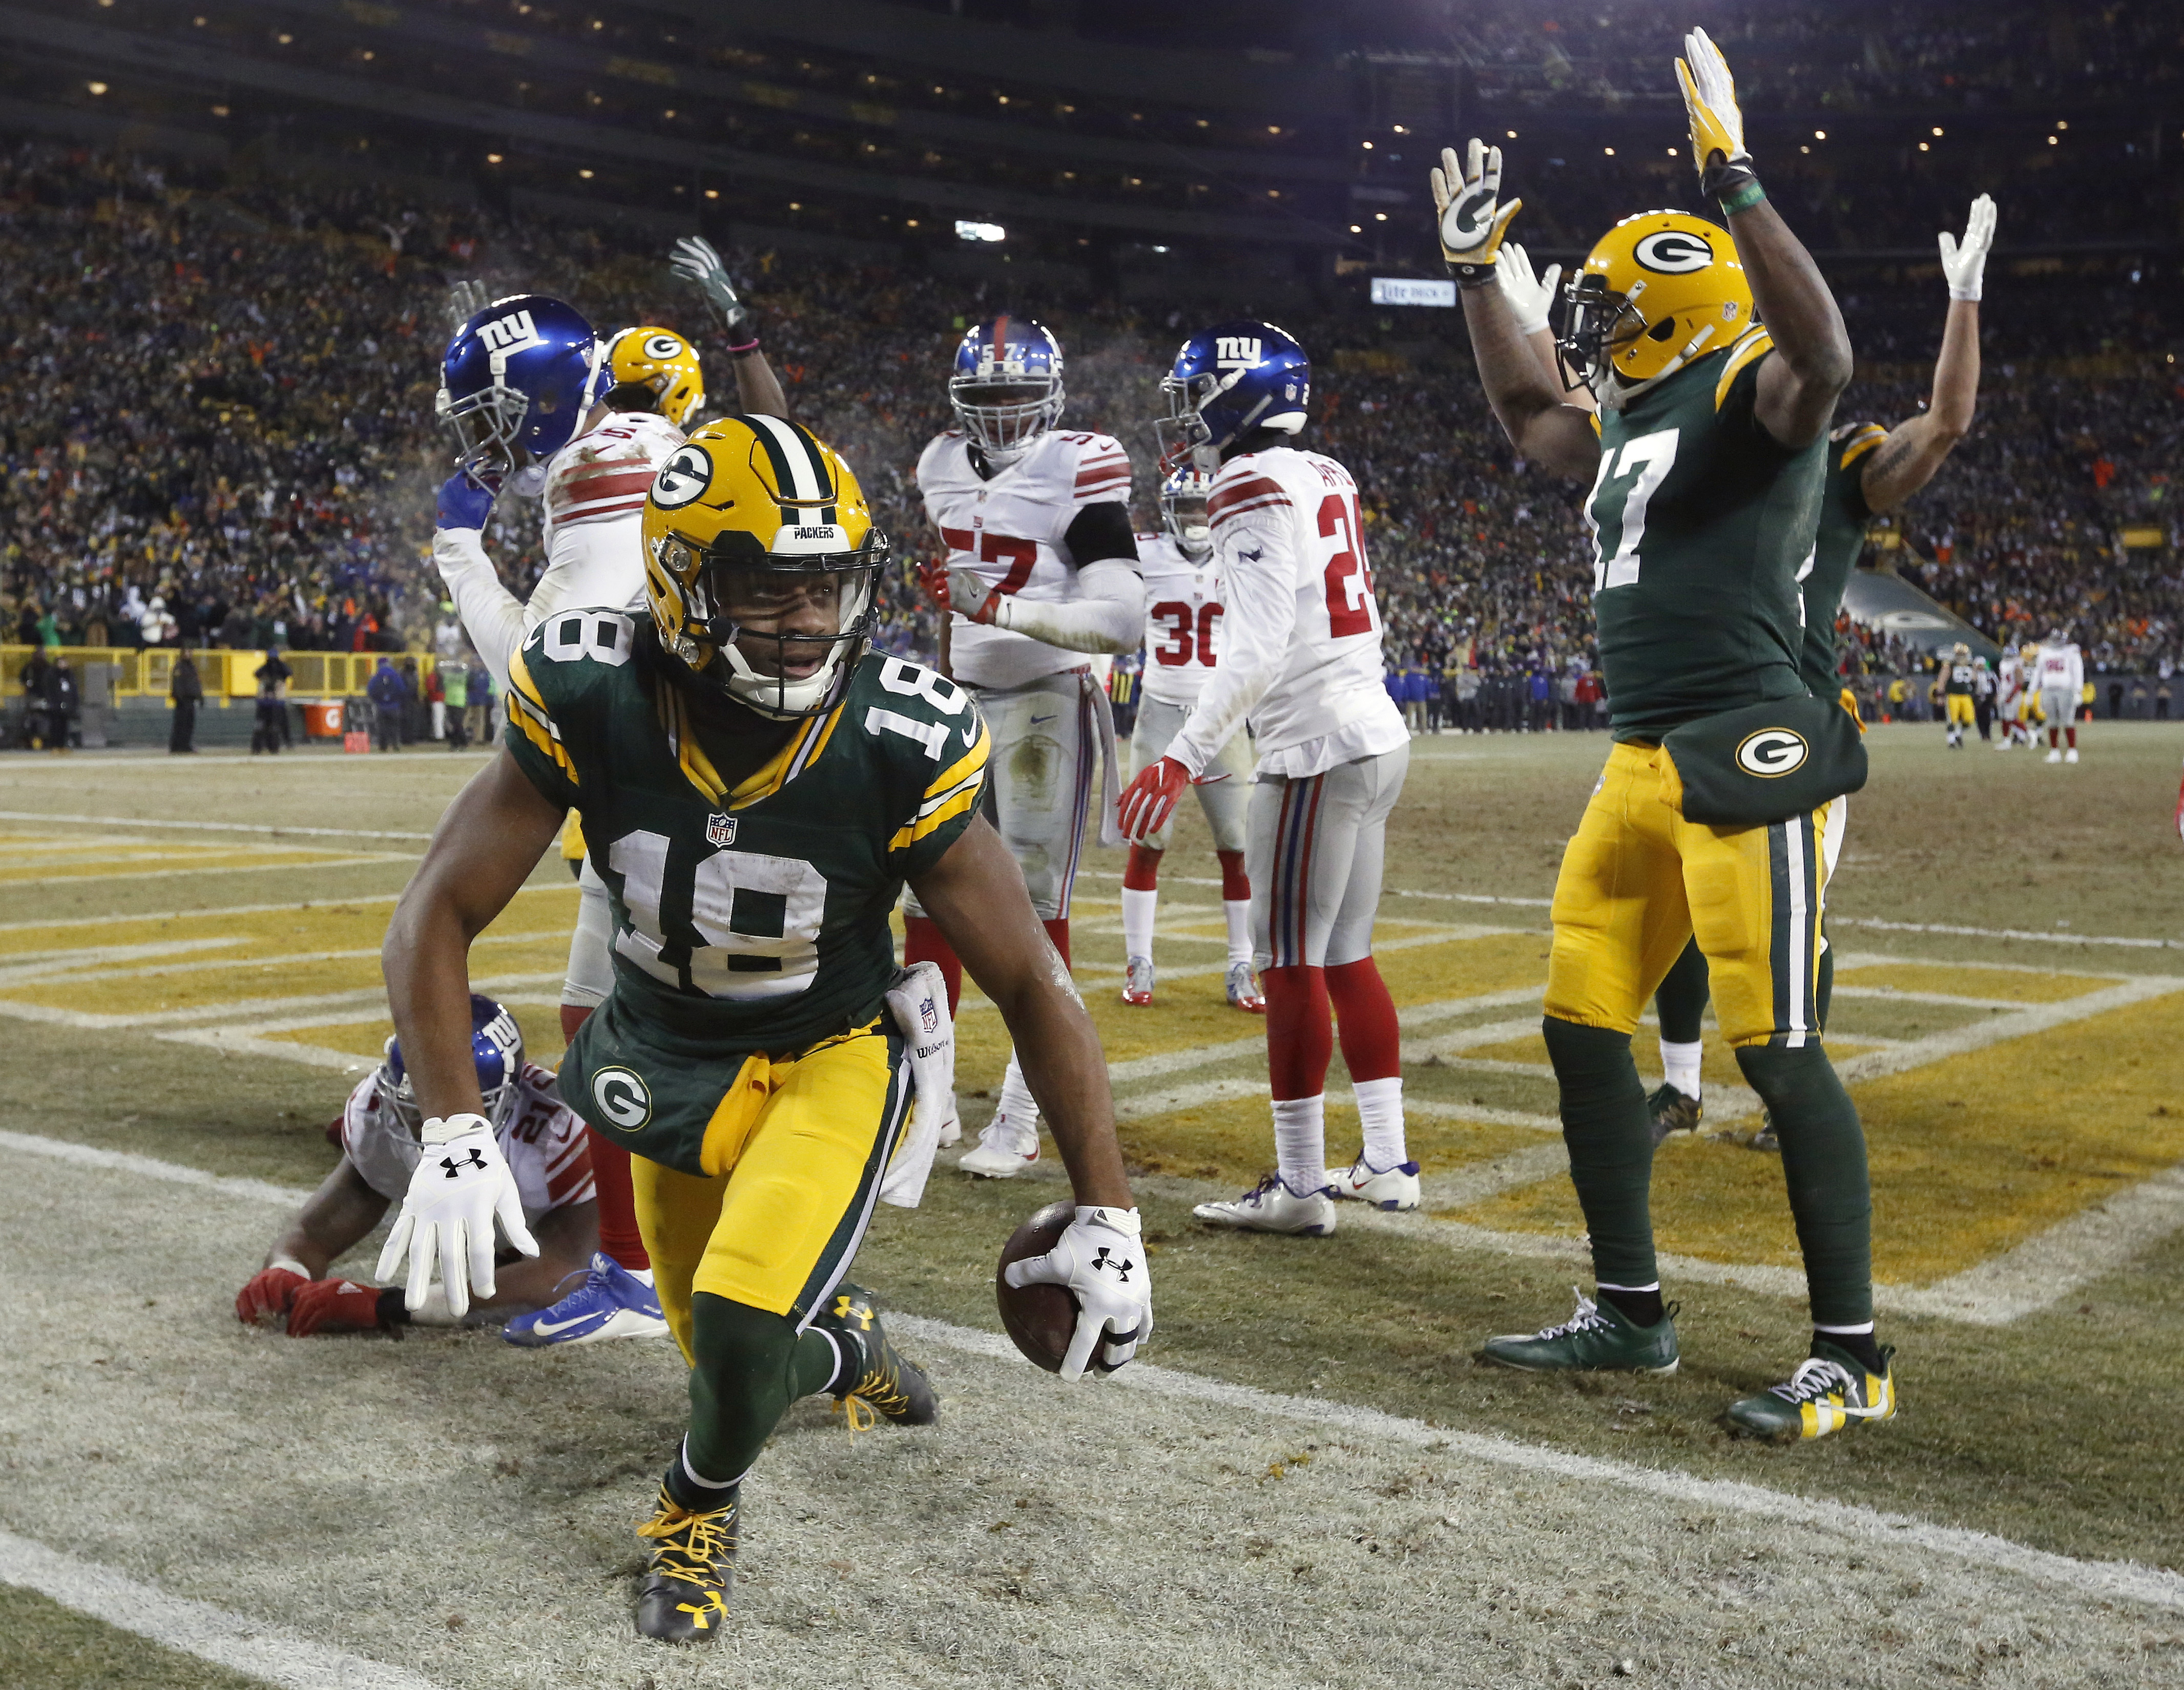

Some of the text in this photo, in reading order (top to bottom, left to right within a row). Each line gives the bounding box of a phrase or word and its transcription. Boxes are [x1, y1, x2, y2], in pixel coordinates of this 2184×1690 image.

[1637, 234, 1714, 272] G
[644, 335, 682, 359] G
[982, 343, 1017, 362] 57
[652, 449, 709, 505] G
[794, 527, 834, 539] PACKERS
[1151, 601, 1224, 666] 30
[864, 657, 970, 762] 18
[1741, 731, 1804, 774] G
[711, 826, 731, 841] NFL
[608, 829, 827, 1001] 18
[922, 1012, 937, 1030] NFL
[916, 1040, 945, 1059] Wilson
[594, 1071, 647, 1127] G
